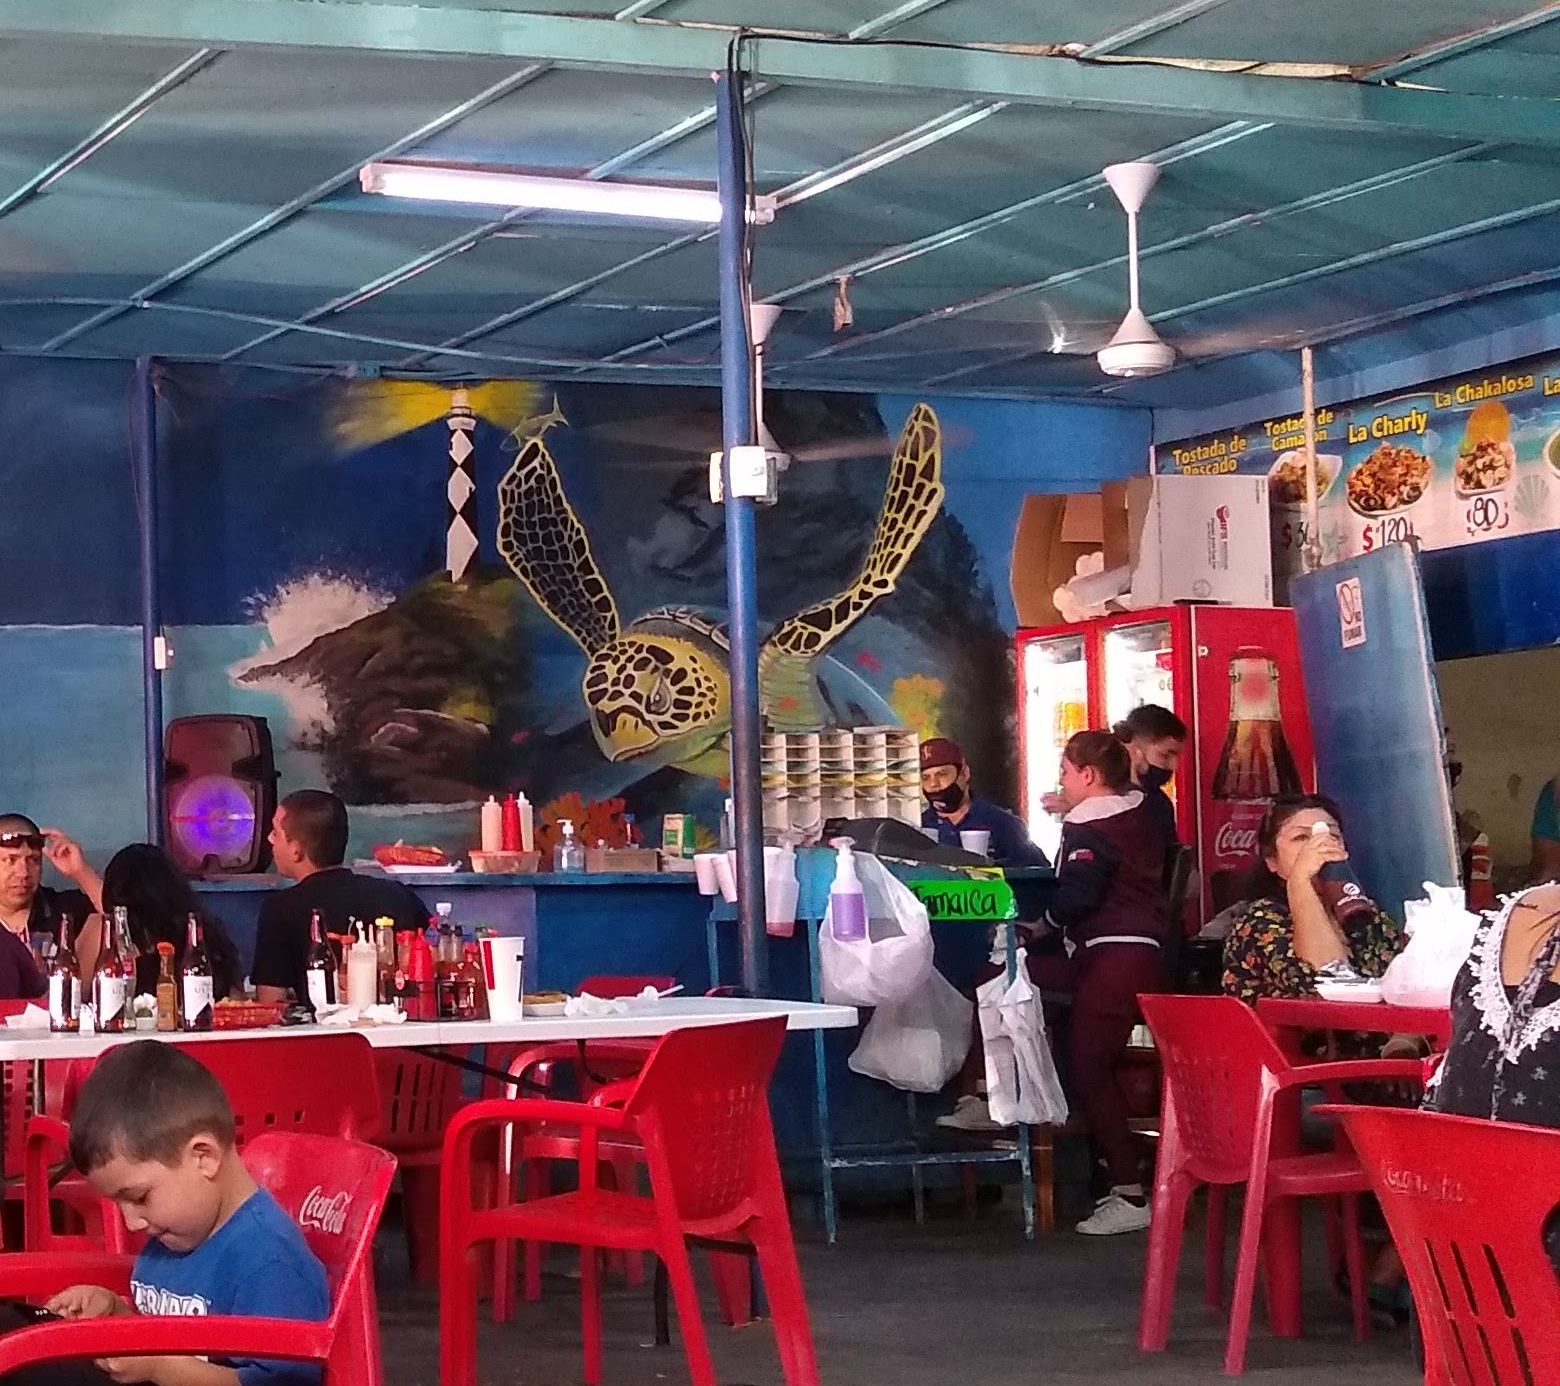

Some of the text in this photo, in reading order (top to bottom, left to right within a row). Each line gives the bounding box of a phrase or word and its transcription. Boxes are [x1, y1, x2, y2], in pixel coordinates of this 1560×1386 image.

[1434, 374, 1535, 409] La Chakalosa
[1317, 409, 1334, 425] de
[1348, 409, 1428, 444] La Charly
[1172, 435, 1247, 465] Tostada de
[1472, 496, 1500, 528] 80
[1376, 516, 1408, 547] 120
